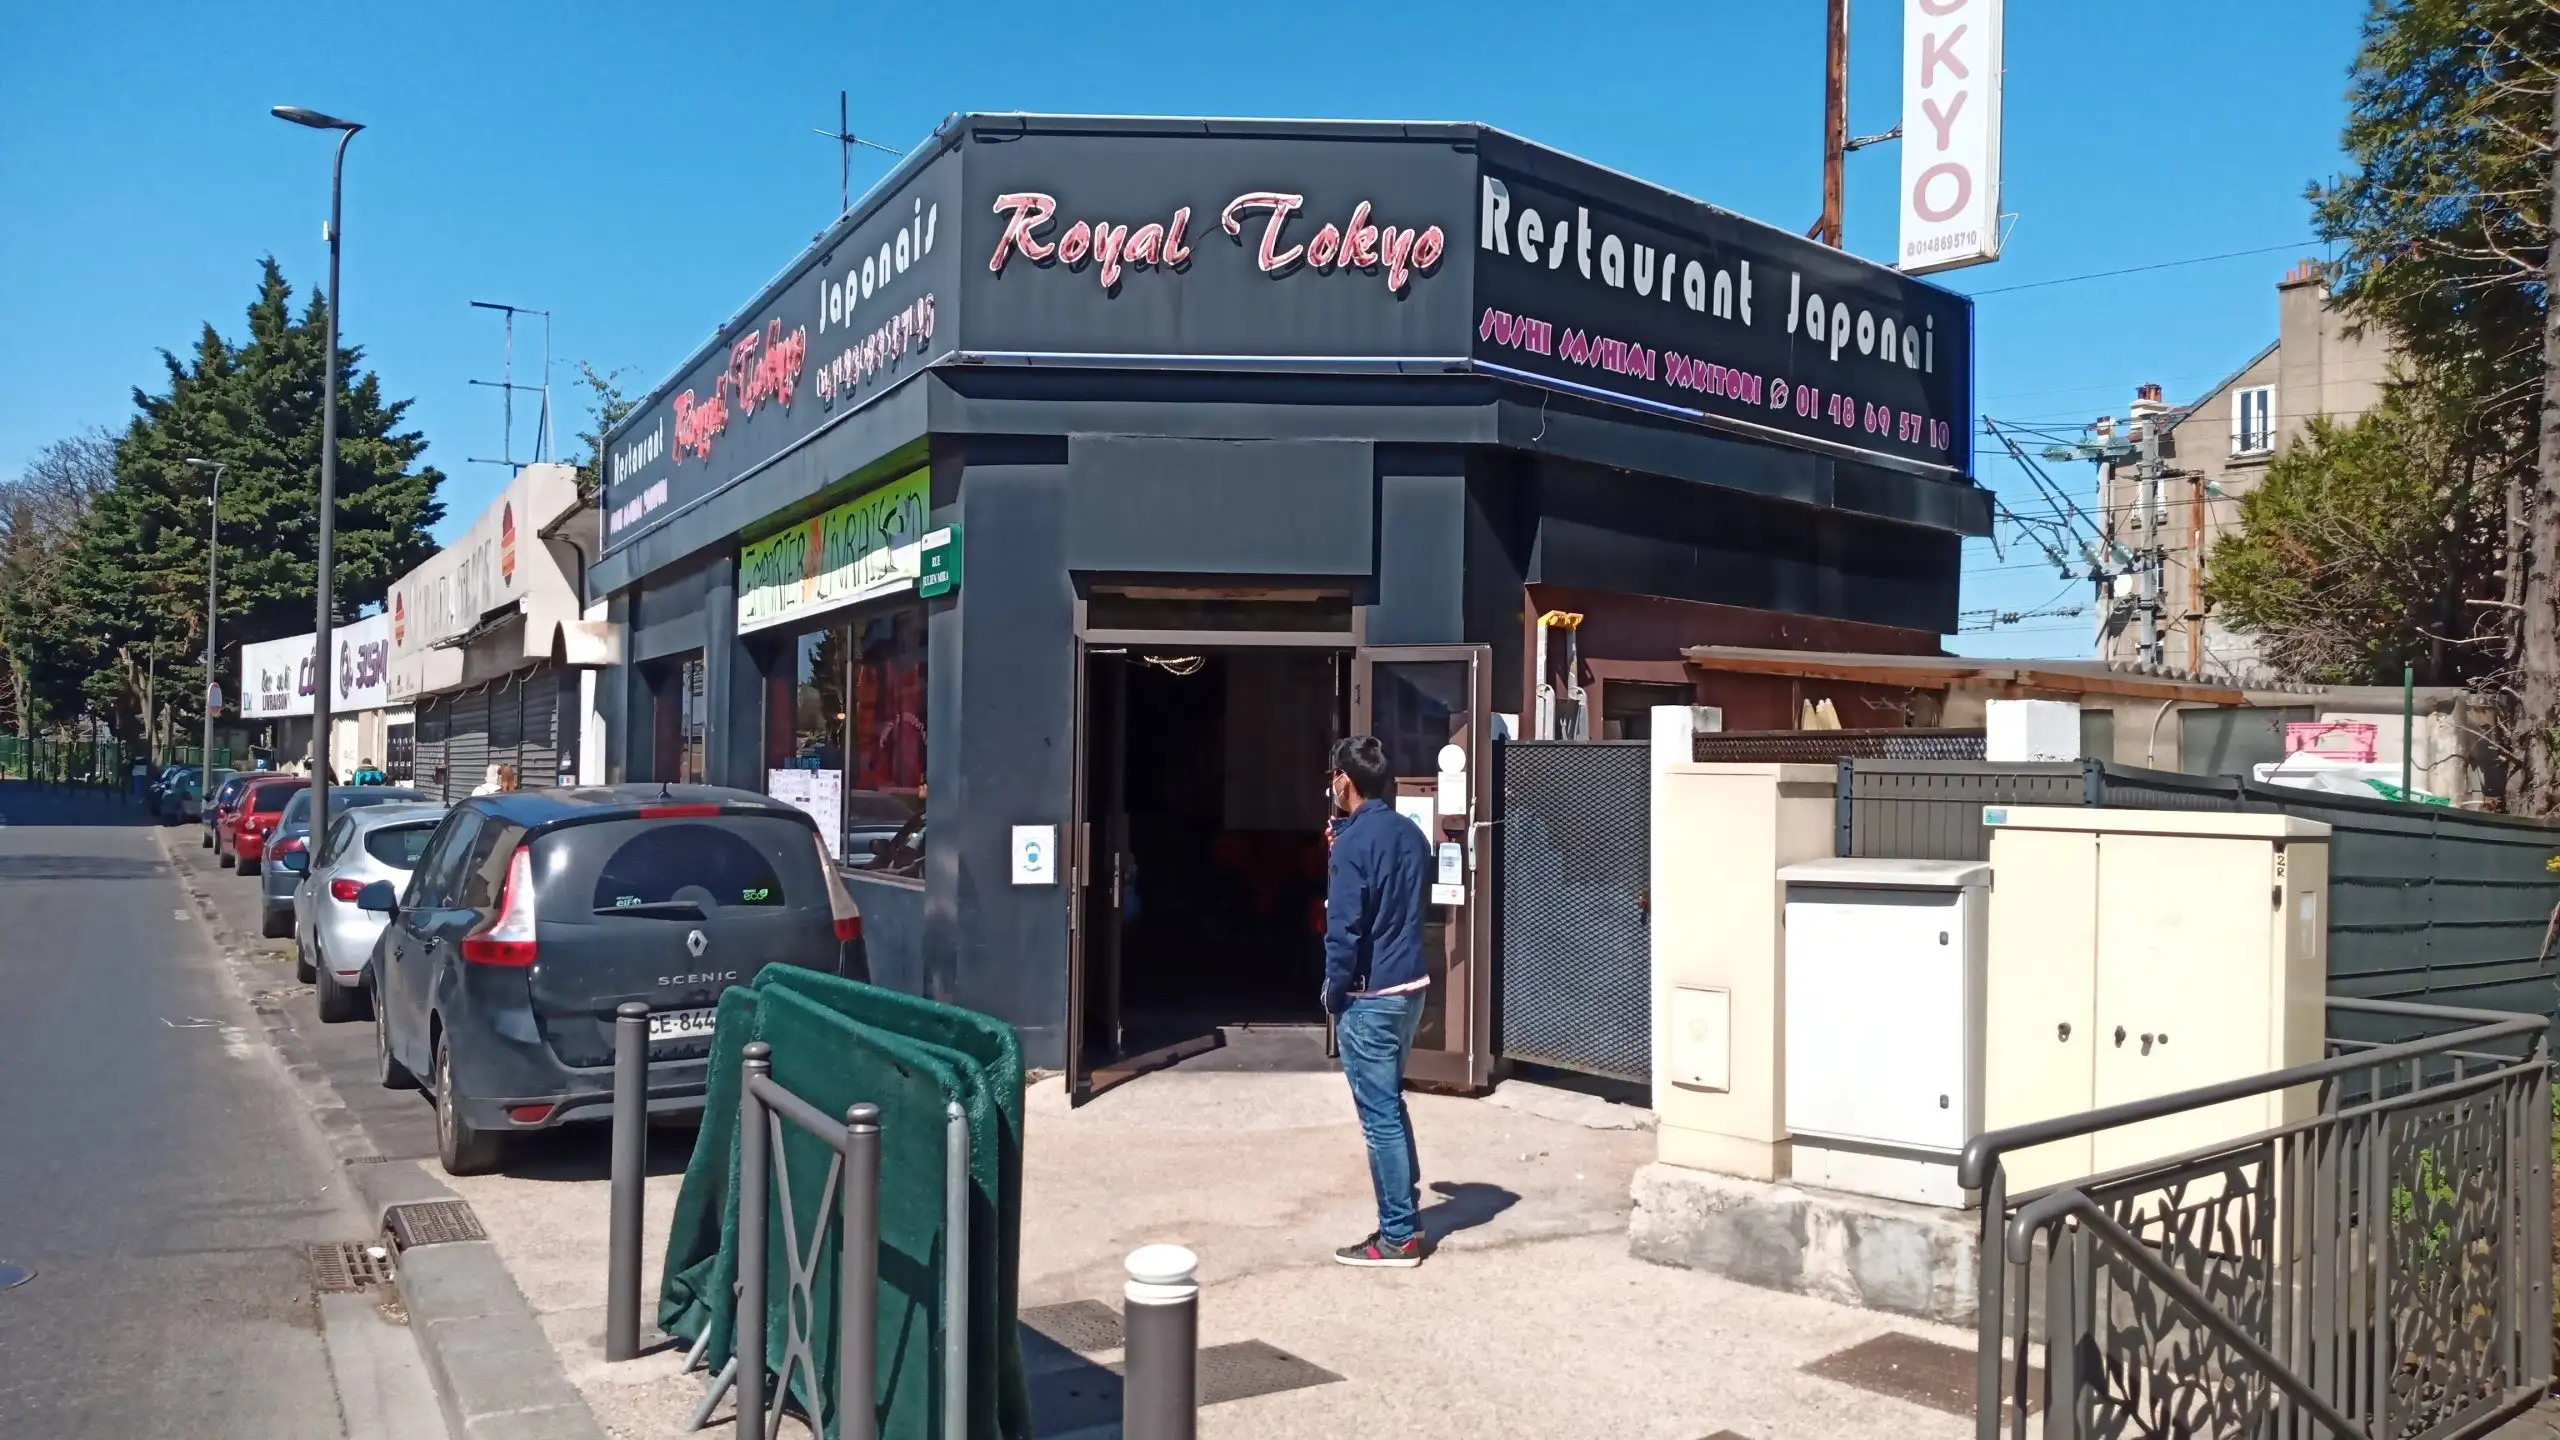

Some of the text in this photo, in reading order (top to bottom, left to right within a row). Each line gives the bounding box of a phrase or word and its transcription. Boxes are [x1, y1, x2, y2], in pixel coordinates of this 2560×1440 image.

[1913, 0, 1972, 223] KYO
[819, 197, 938, 335] Japonais
[989, 191, 1445, 293] Royal Tokyo
[1480, 174, 1934, 374] Restaurant Japonai
[1479, 306, 1950, 452] SUSHI SASHIMI YAKITORI 01 48 69 57 10
[613, 416, 664, 487] Restaurant
[657, 970, 738, 986] SCENIC
